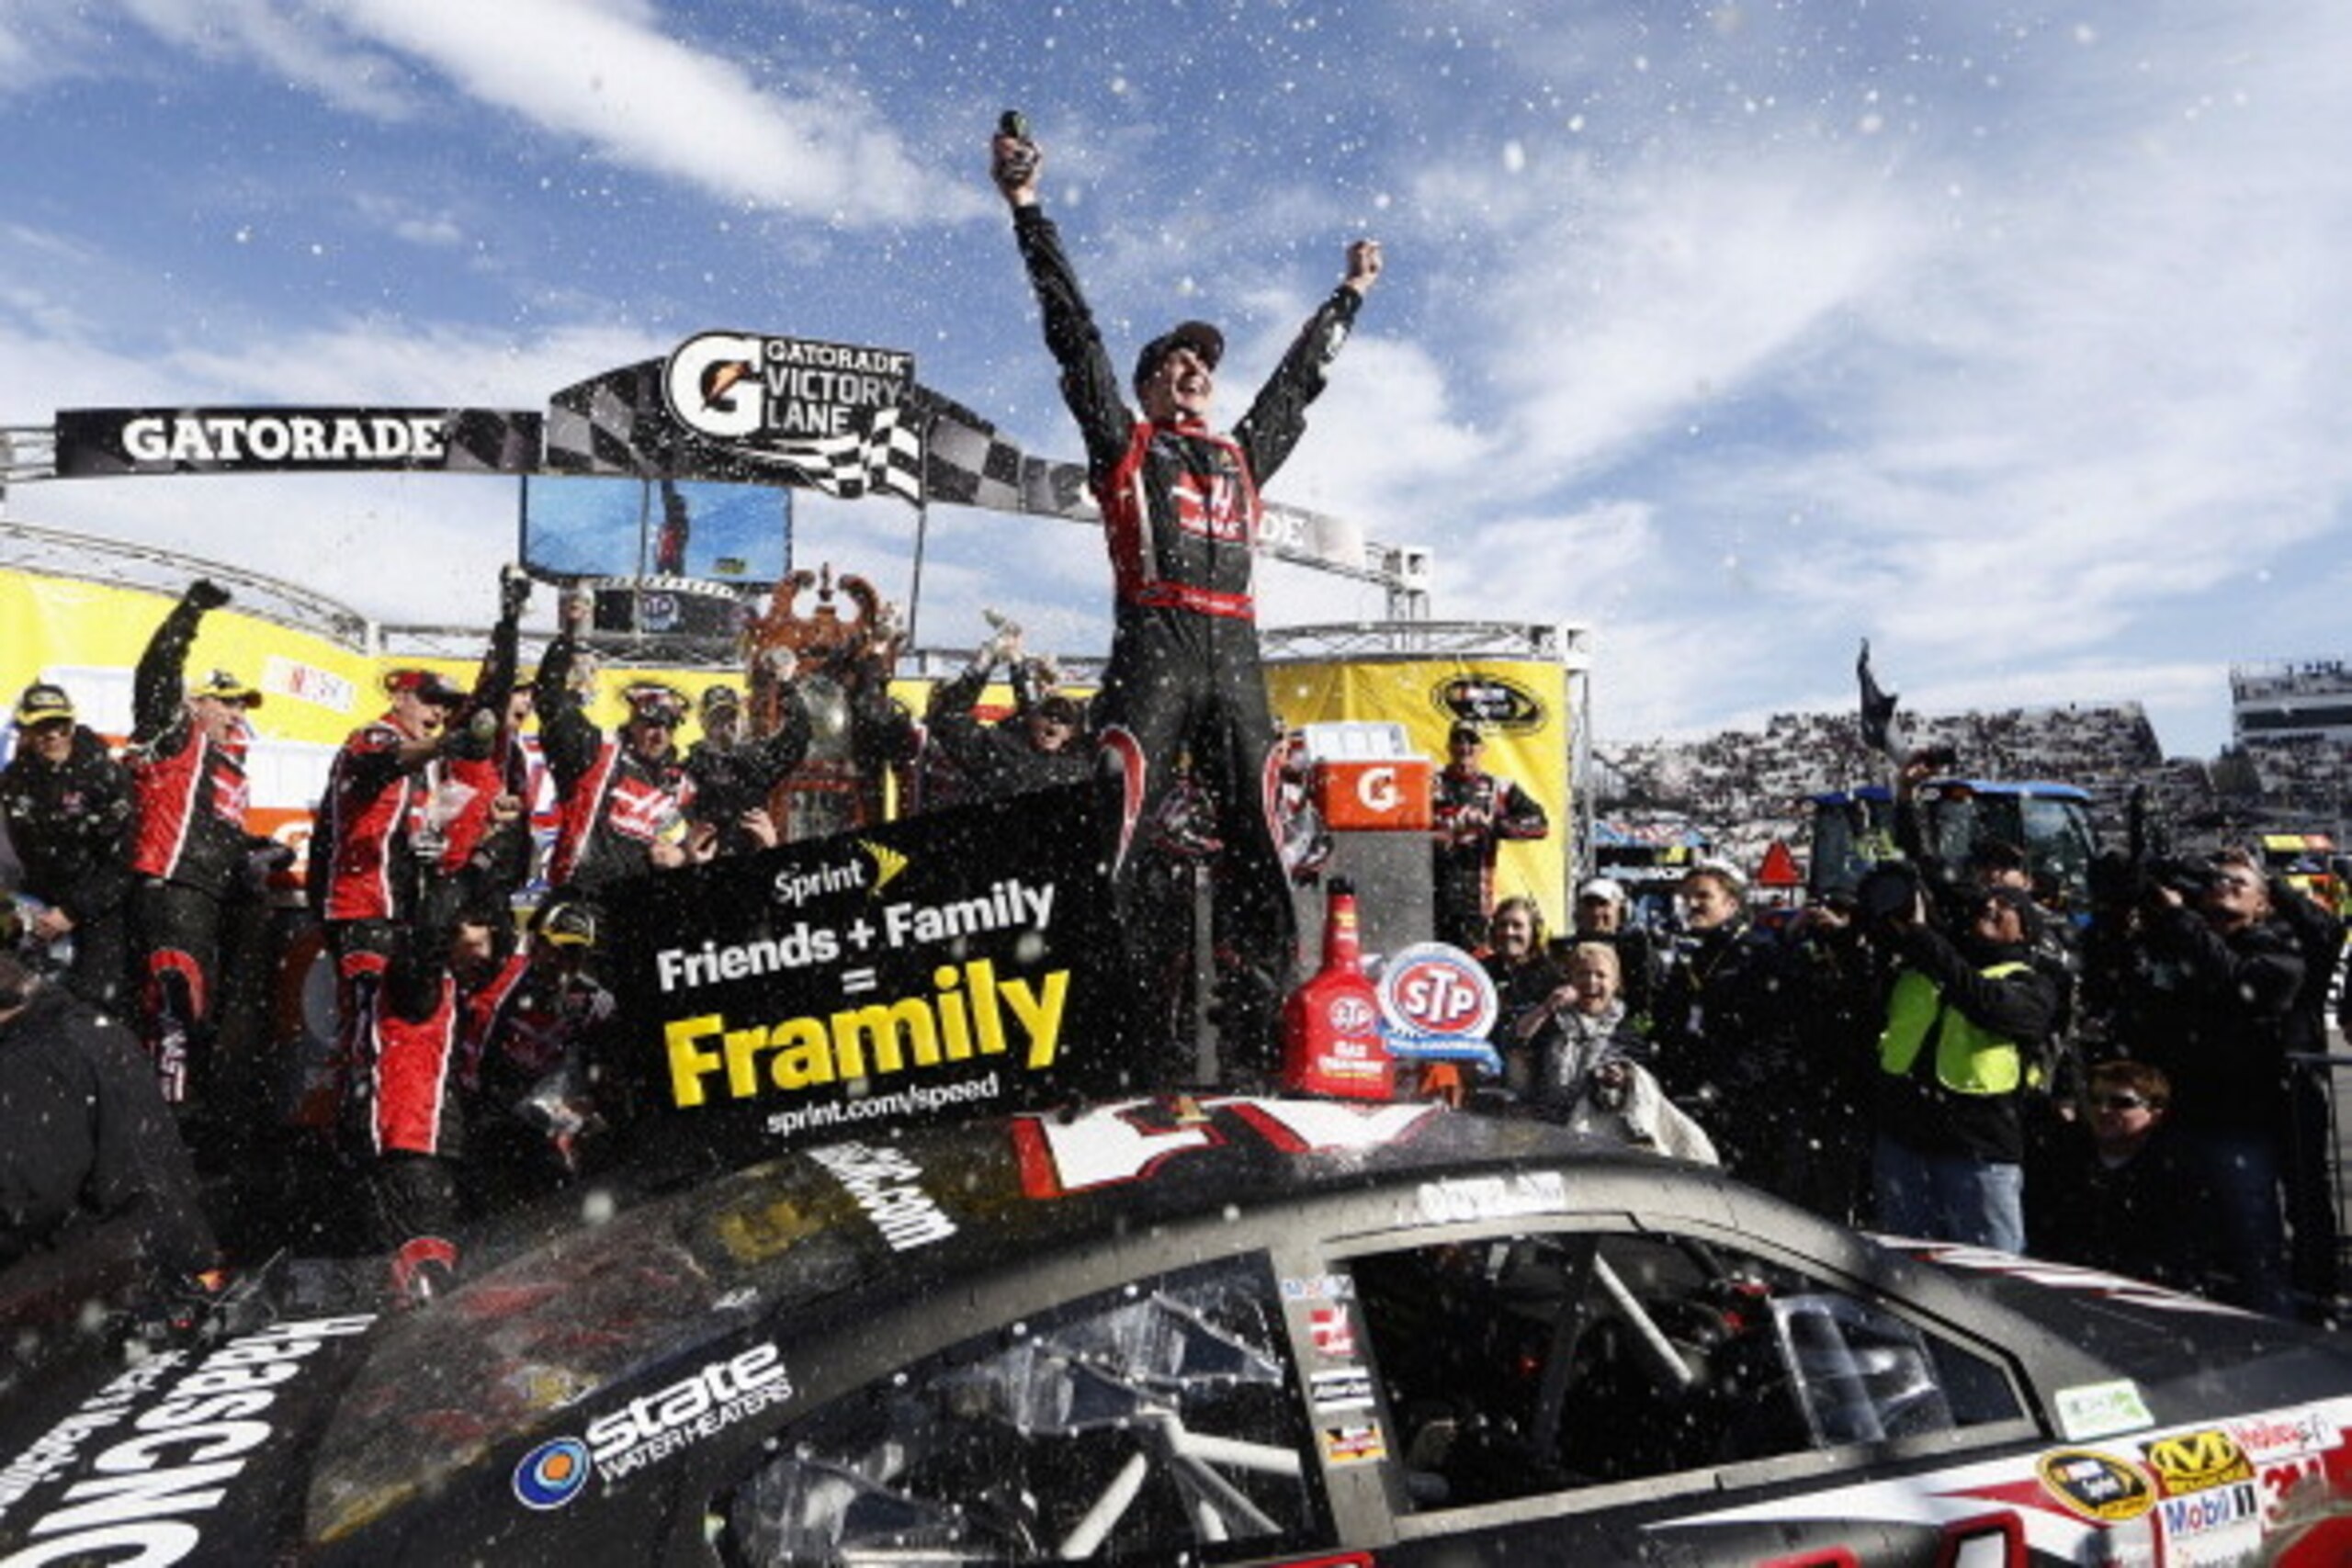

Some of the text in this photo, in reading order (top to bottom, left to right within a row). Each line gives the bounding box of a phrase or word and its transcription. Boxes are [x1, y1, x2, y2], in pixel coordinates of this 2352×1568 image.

[766, 339, 904, 376] GATORADE
[766, 367, 903, 406] VICTORY
[121, 417, 445, 461] GATORADE
[766, 399, 852, 434] LANE
[775, 860, 865, 907] Sprint
[656, 922, 840, 992] Friends
[884, 877, 1056, 950] Family
[1405, 969, 1476, 1022] STP
[664, 957, 1069, 1108] Framily
[766, 1072, 1000, 1137] sprint.com/speed
[585, 1342, 786, 1463] state
[597, 1377, 794, 1483] WATER HEATERS
[2164, 1489, 2231, 1535] Mobil
[2233, 1481, 2257, 1518] 1
